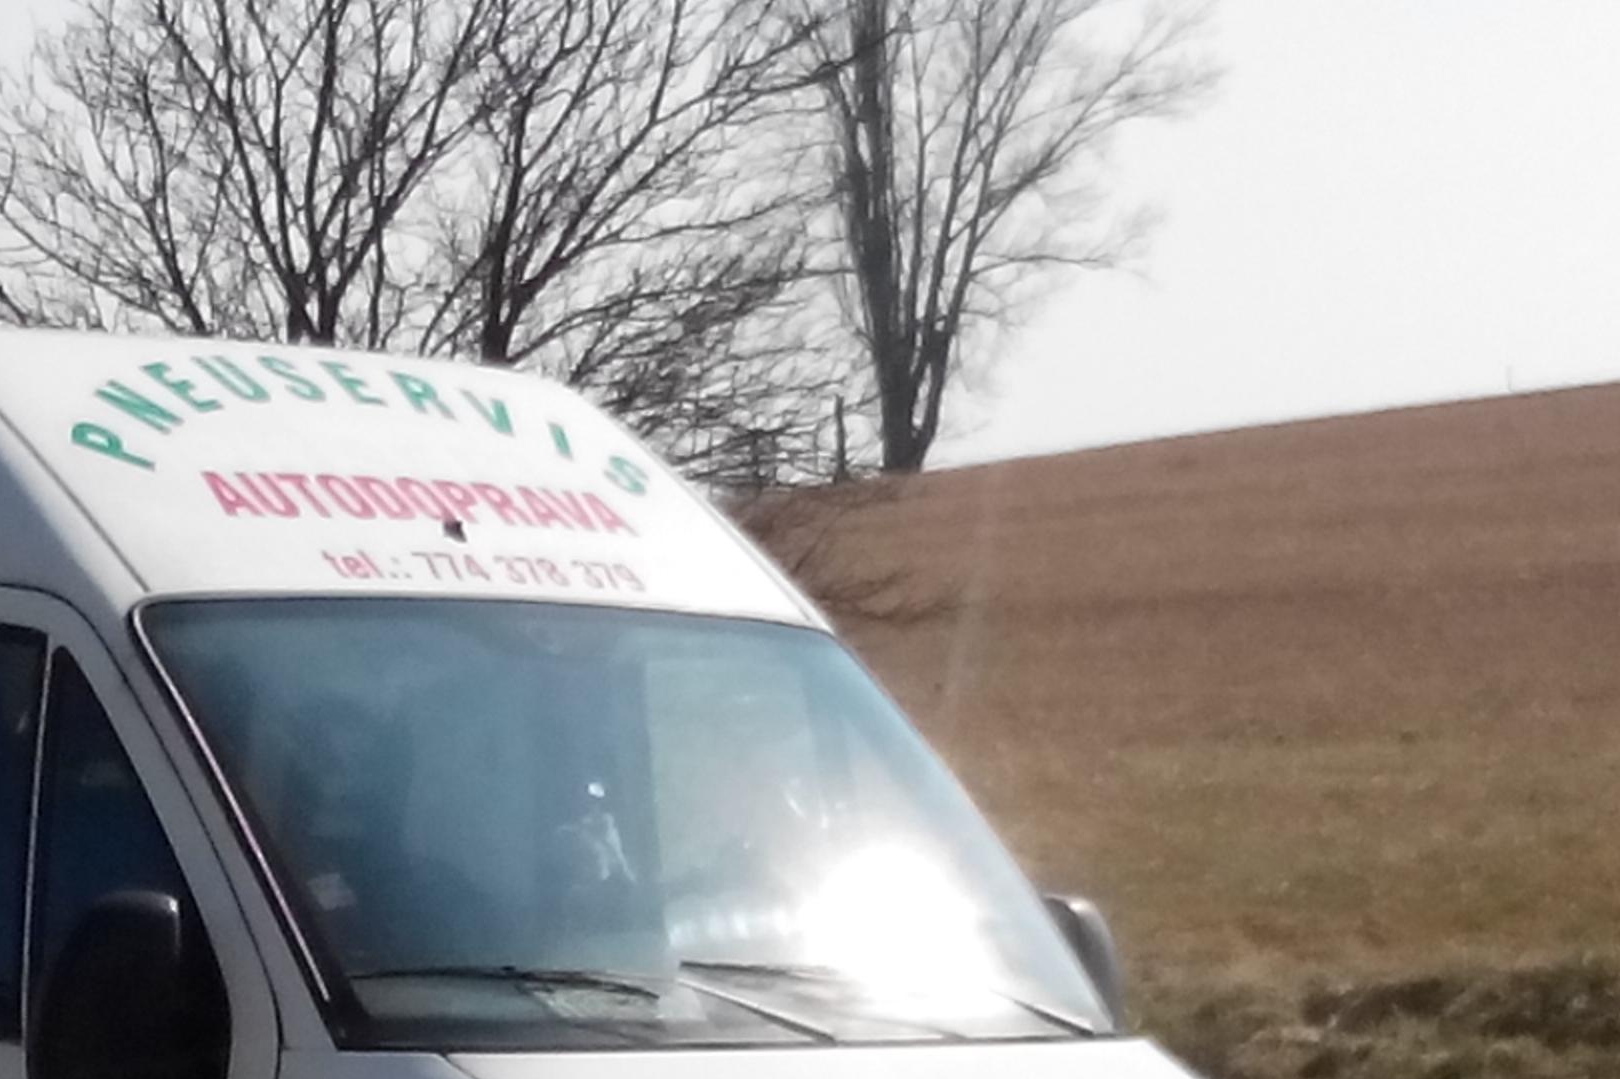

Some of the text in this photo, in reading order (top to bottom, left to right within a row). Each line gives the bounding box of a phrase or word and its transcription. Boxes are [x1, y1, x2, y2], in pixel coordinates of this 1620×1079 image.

[70, 353, 650, 496] PNEUSERVIS
[200, 470, 640, 537] AUTODOPRAVA
[321, 549, 647, 593] tel.: 774 378 379
